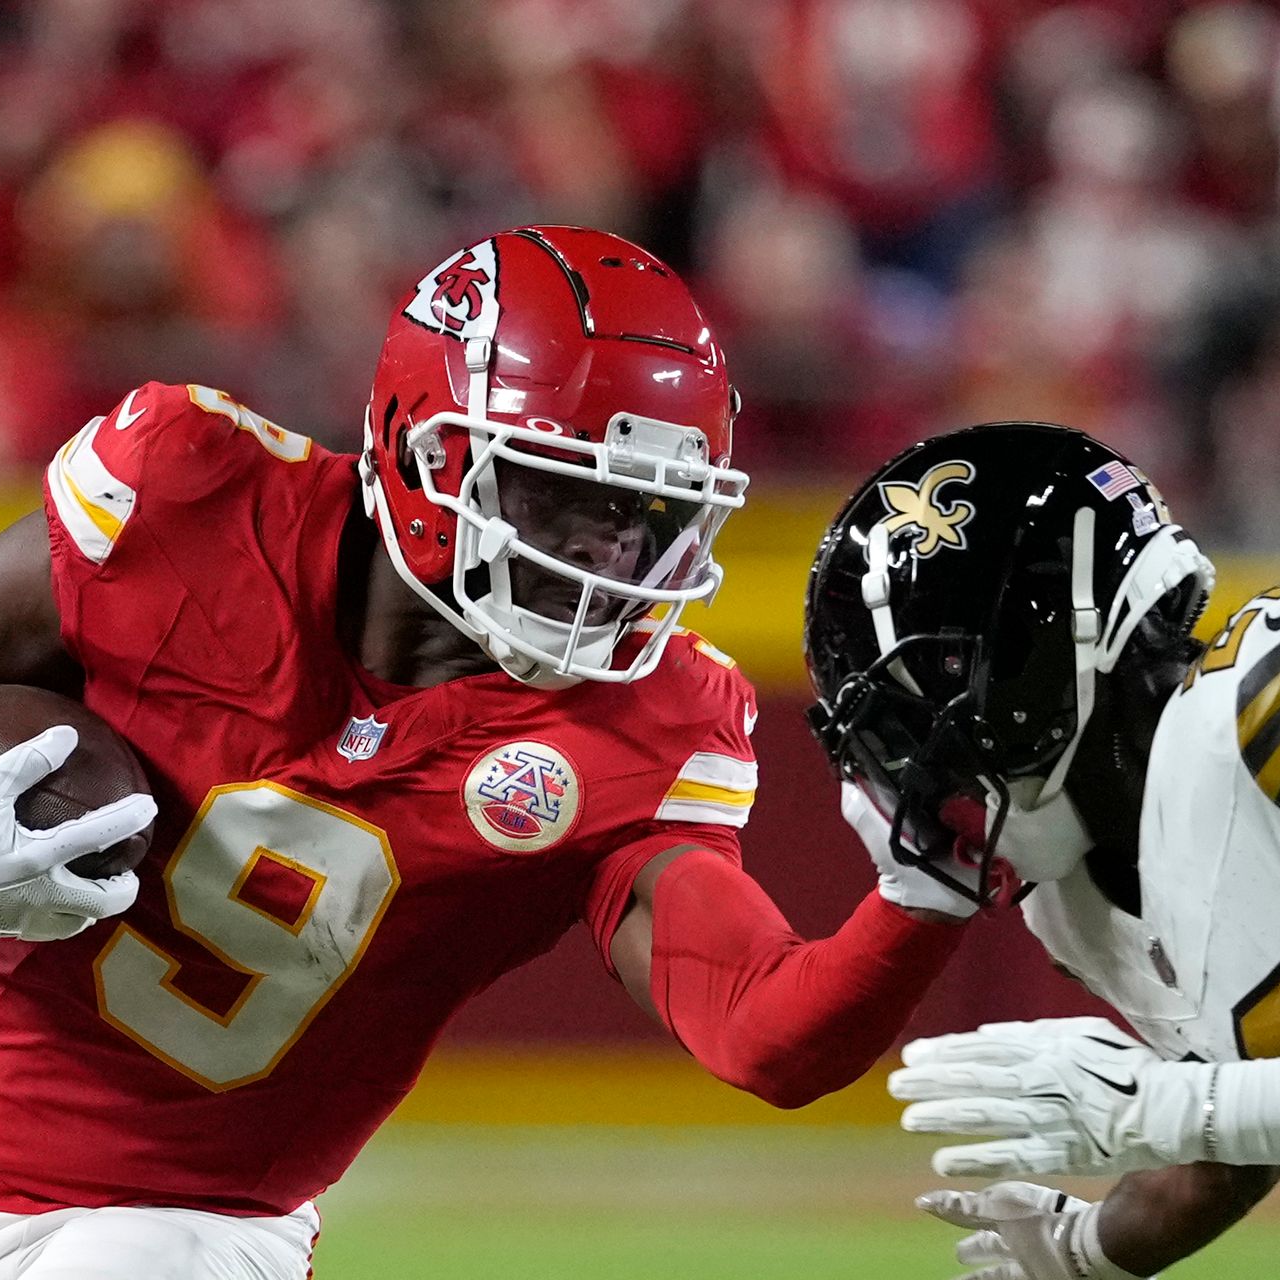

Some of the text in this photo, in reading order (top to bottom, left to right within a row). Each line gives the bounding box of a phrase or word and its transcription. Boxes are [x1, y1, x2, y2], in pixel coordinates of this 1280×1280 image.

[431, 251, 491, 332] KC
[345, 733, 373, 754] NFL
[91, 778, 402, 1094] 9
